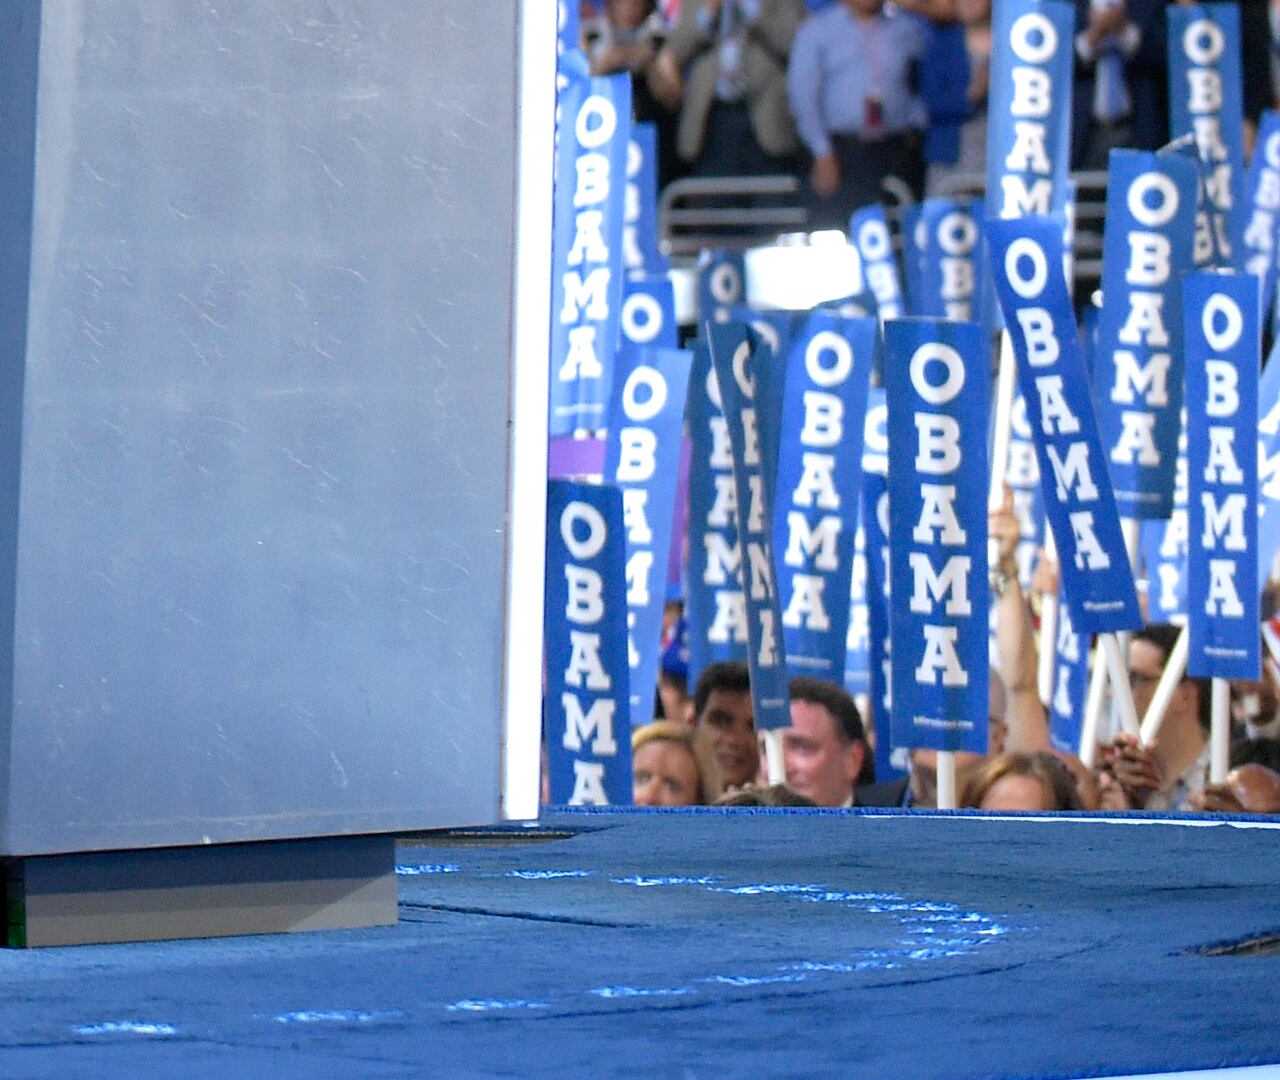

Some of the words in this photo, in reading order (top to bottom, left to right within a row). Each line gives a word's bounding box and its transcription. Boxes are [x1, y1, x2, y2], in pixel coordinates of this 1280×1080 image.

[559, 95, 617, 381] OBAMA
[999, 12, 1058, 221] OBAM
[1004, 236, 1111, 571] OBAMA
[1110, 171, 1181, 466] OBAMA
[1201, 292, 1248, 618] OBAMA
[616, 365, 668, 668] OBAM
[782, 330, 854, 632] OBAMA
[908, 341, 973, 687] OBAMA
[560, 500, 618, 806] OBAMA
